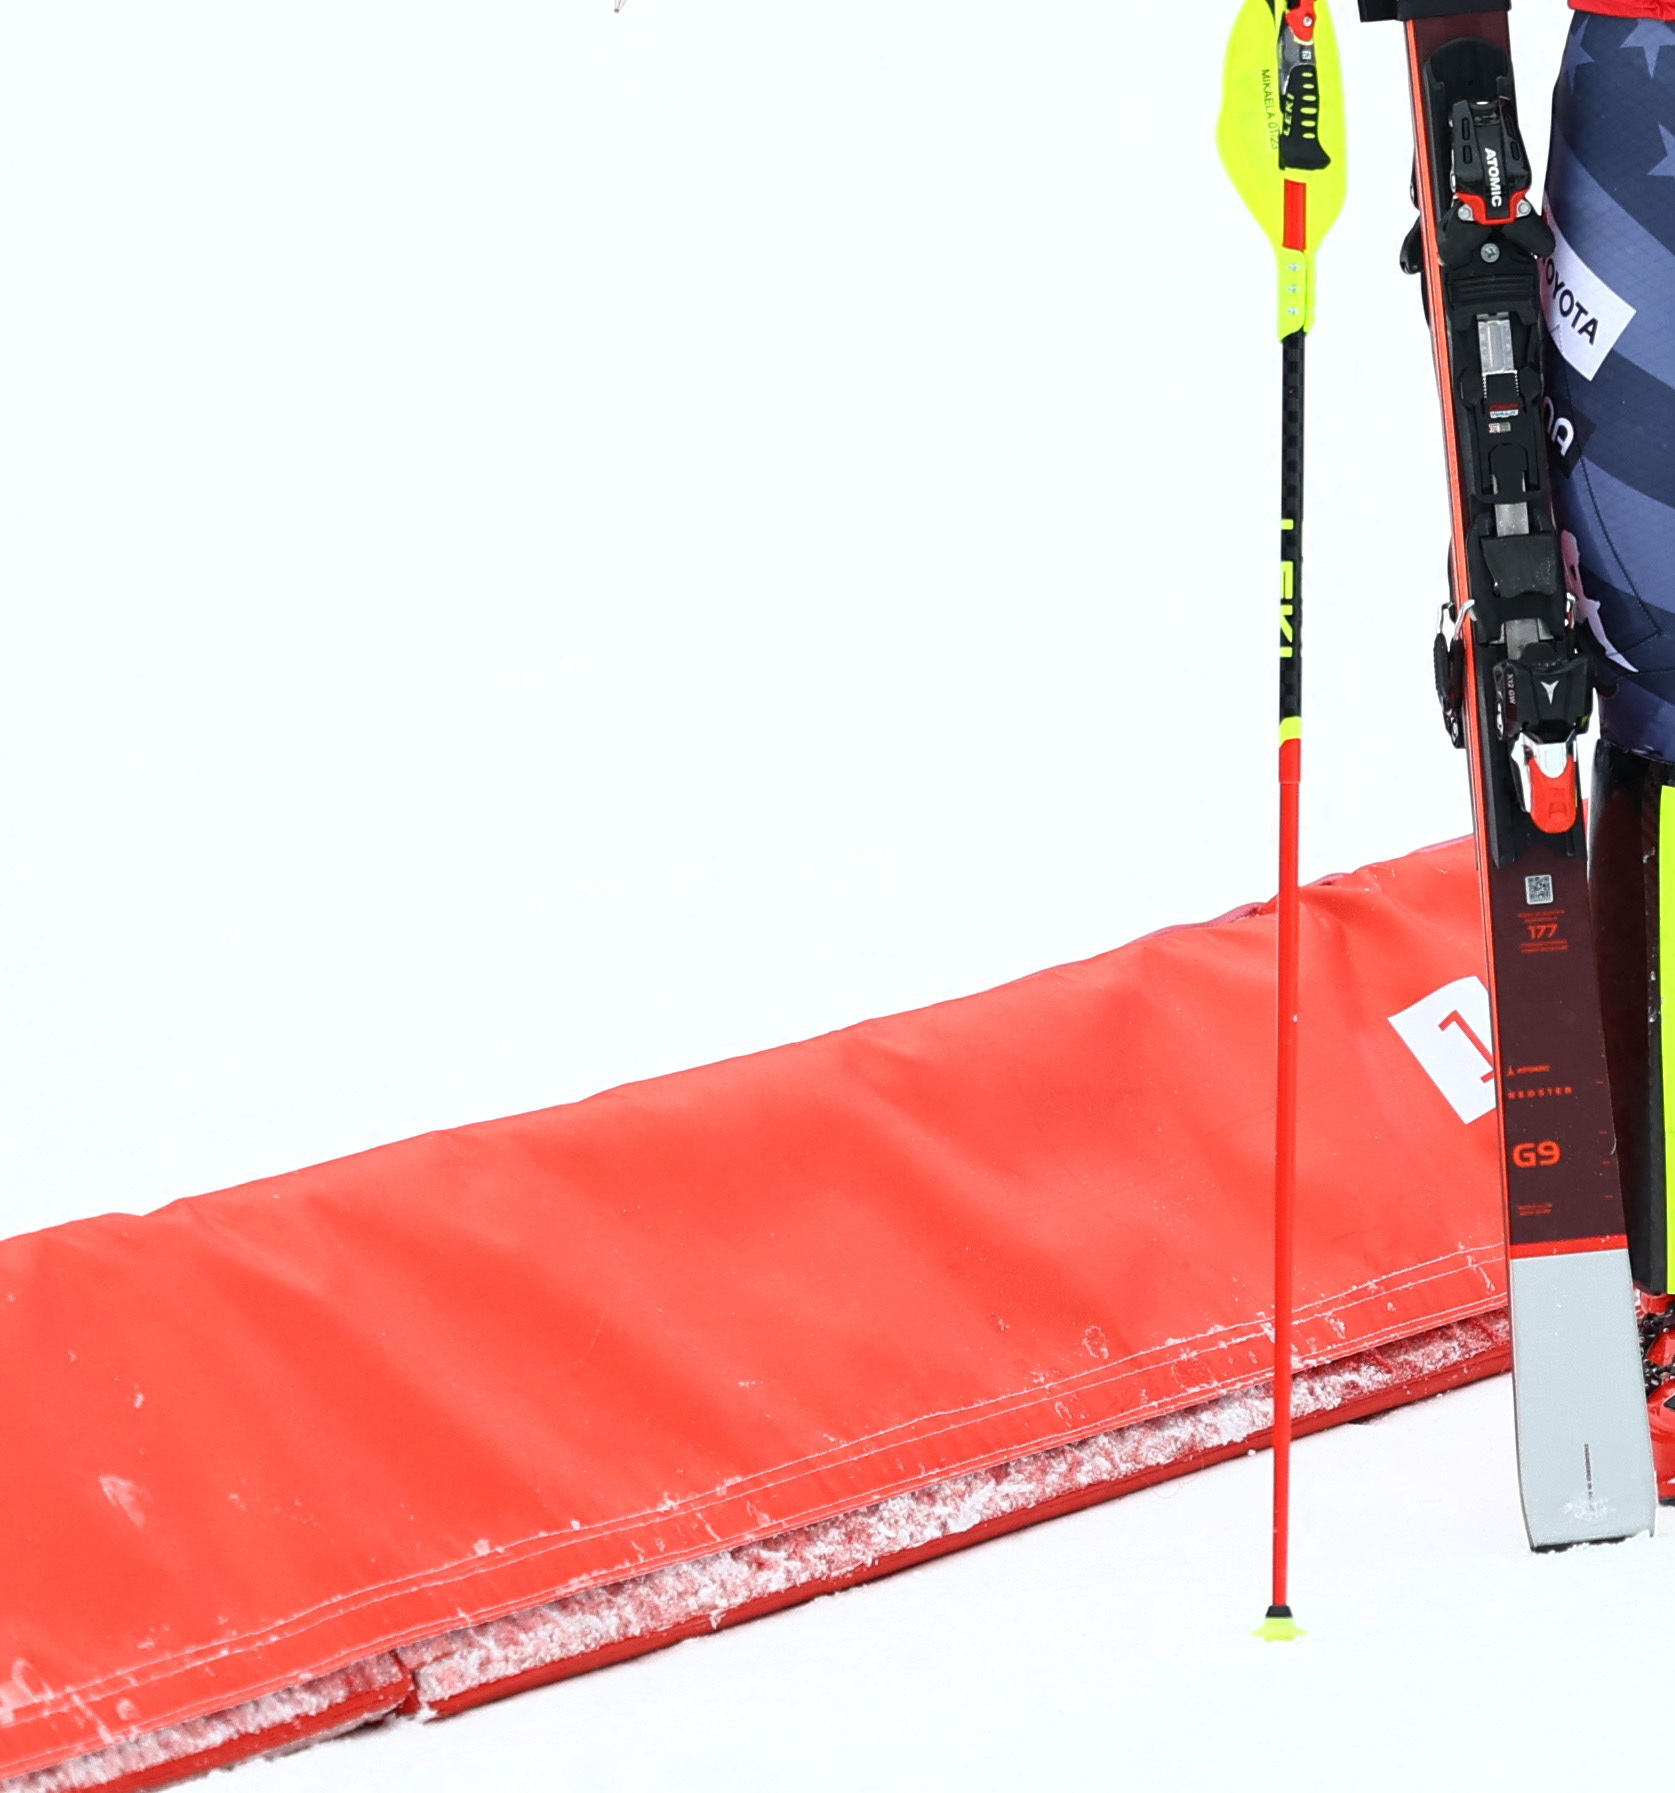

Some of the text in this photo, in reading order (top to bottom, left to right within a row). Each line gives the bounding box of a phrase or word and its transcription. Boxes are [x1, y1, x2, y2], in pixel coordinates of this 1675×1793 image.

[1260, 68, 1276, 121] MIKAELA
[1282, 92, 1296, 137] LEKI
[1483, 147, 1503, 208] ATOMIC
[1541, 254, 1600, 347] OYOTA
[1527, 923, 1560, 941] 177
[1506, 1086, 1574, 1100] REDSTER
[1511, 1140, 1562, 1169] G9
